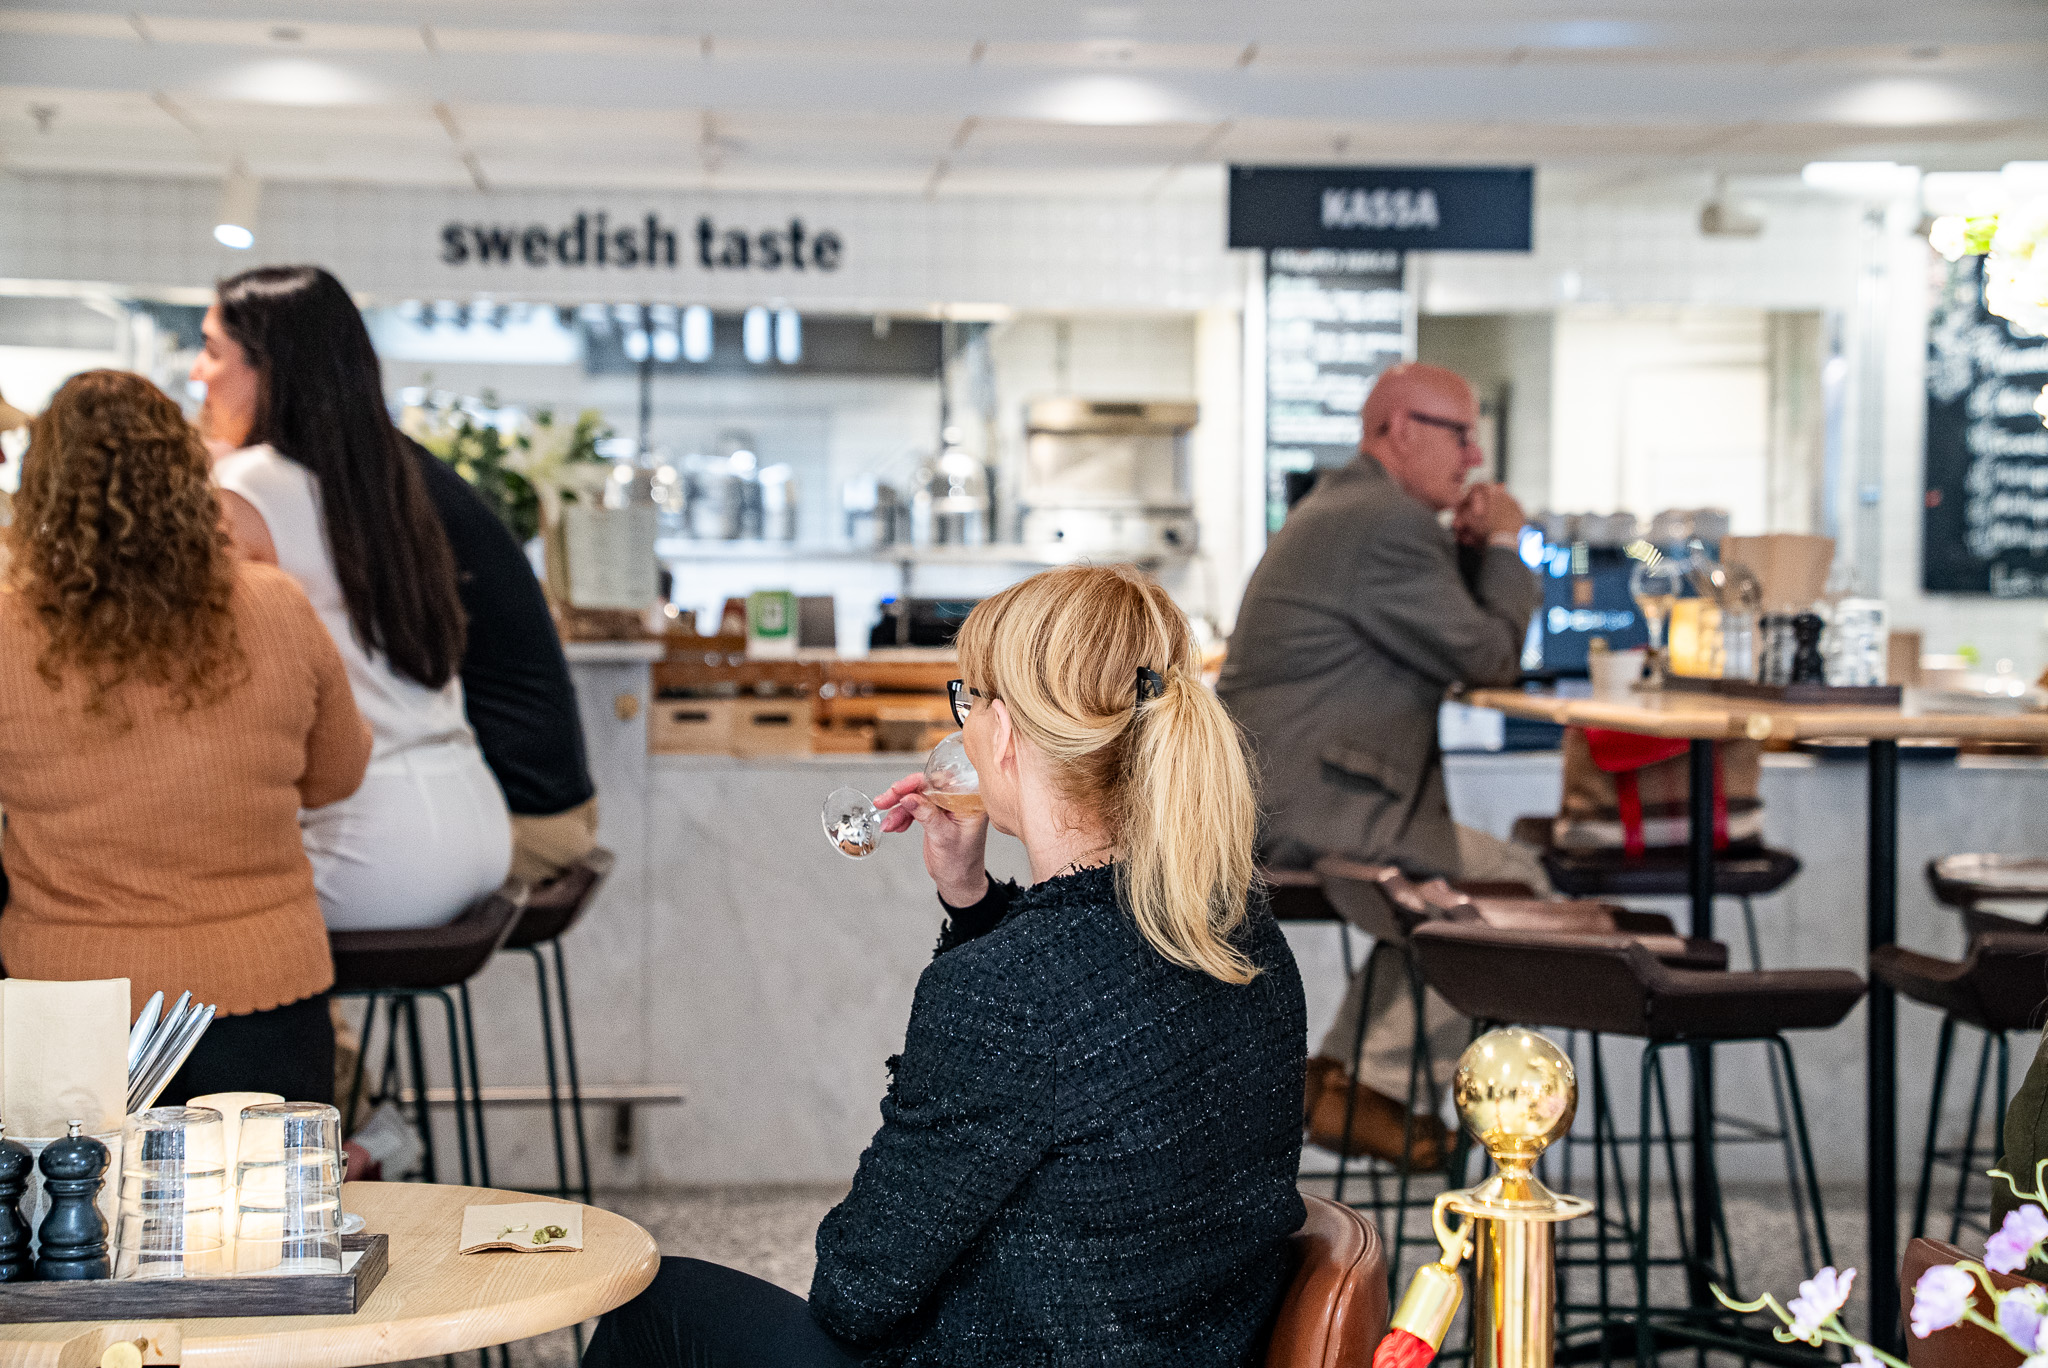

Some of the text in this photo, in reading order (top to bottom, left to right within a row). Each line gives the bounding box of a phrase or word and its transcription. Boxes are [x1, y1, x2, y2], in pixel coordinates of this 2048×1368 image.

[1321, 188, 1440, 229] KASSA
[441, 210, 843, 271] swedish taste
